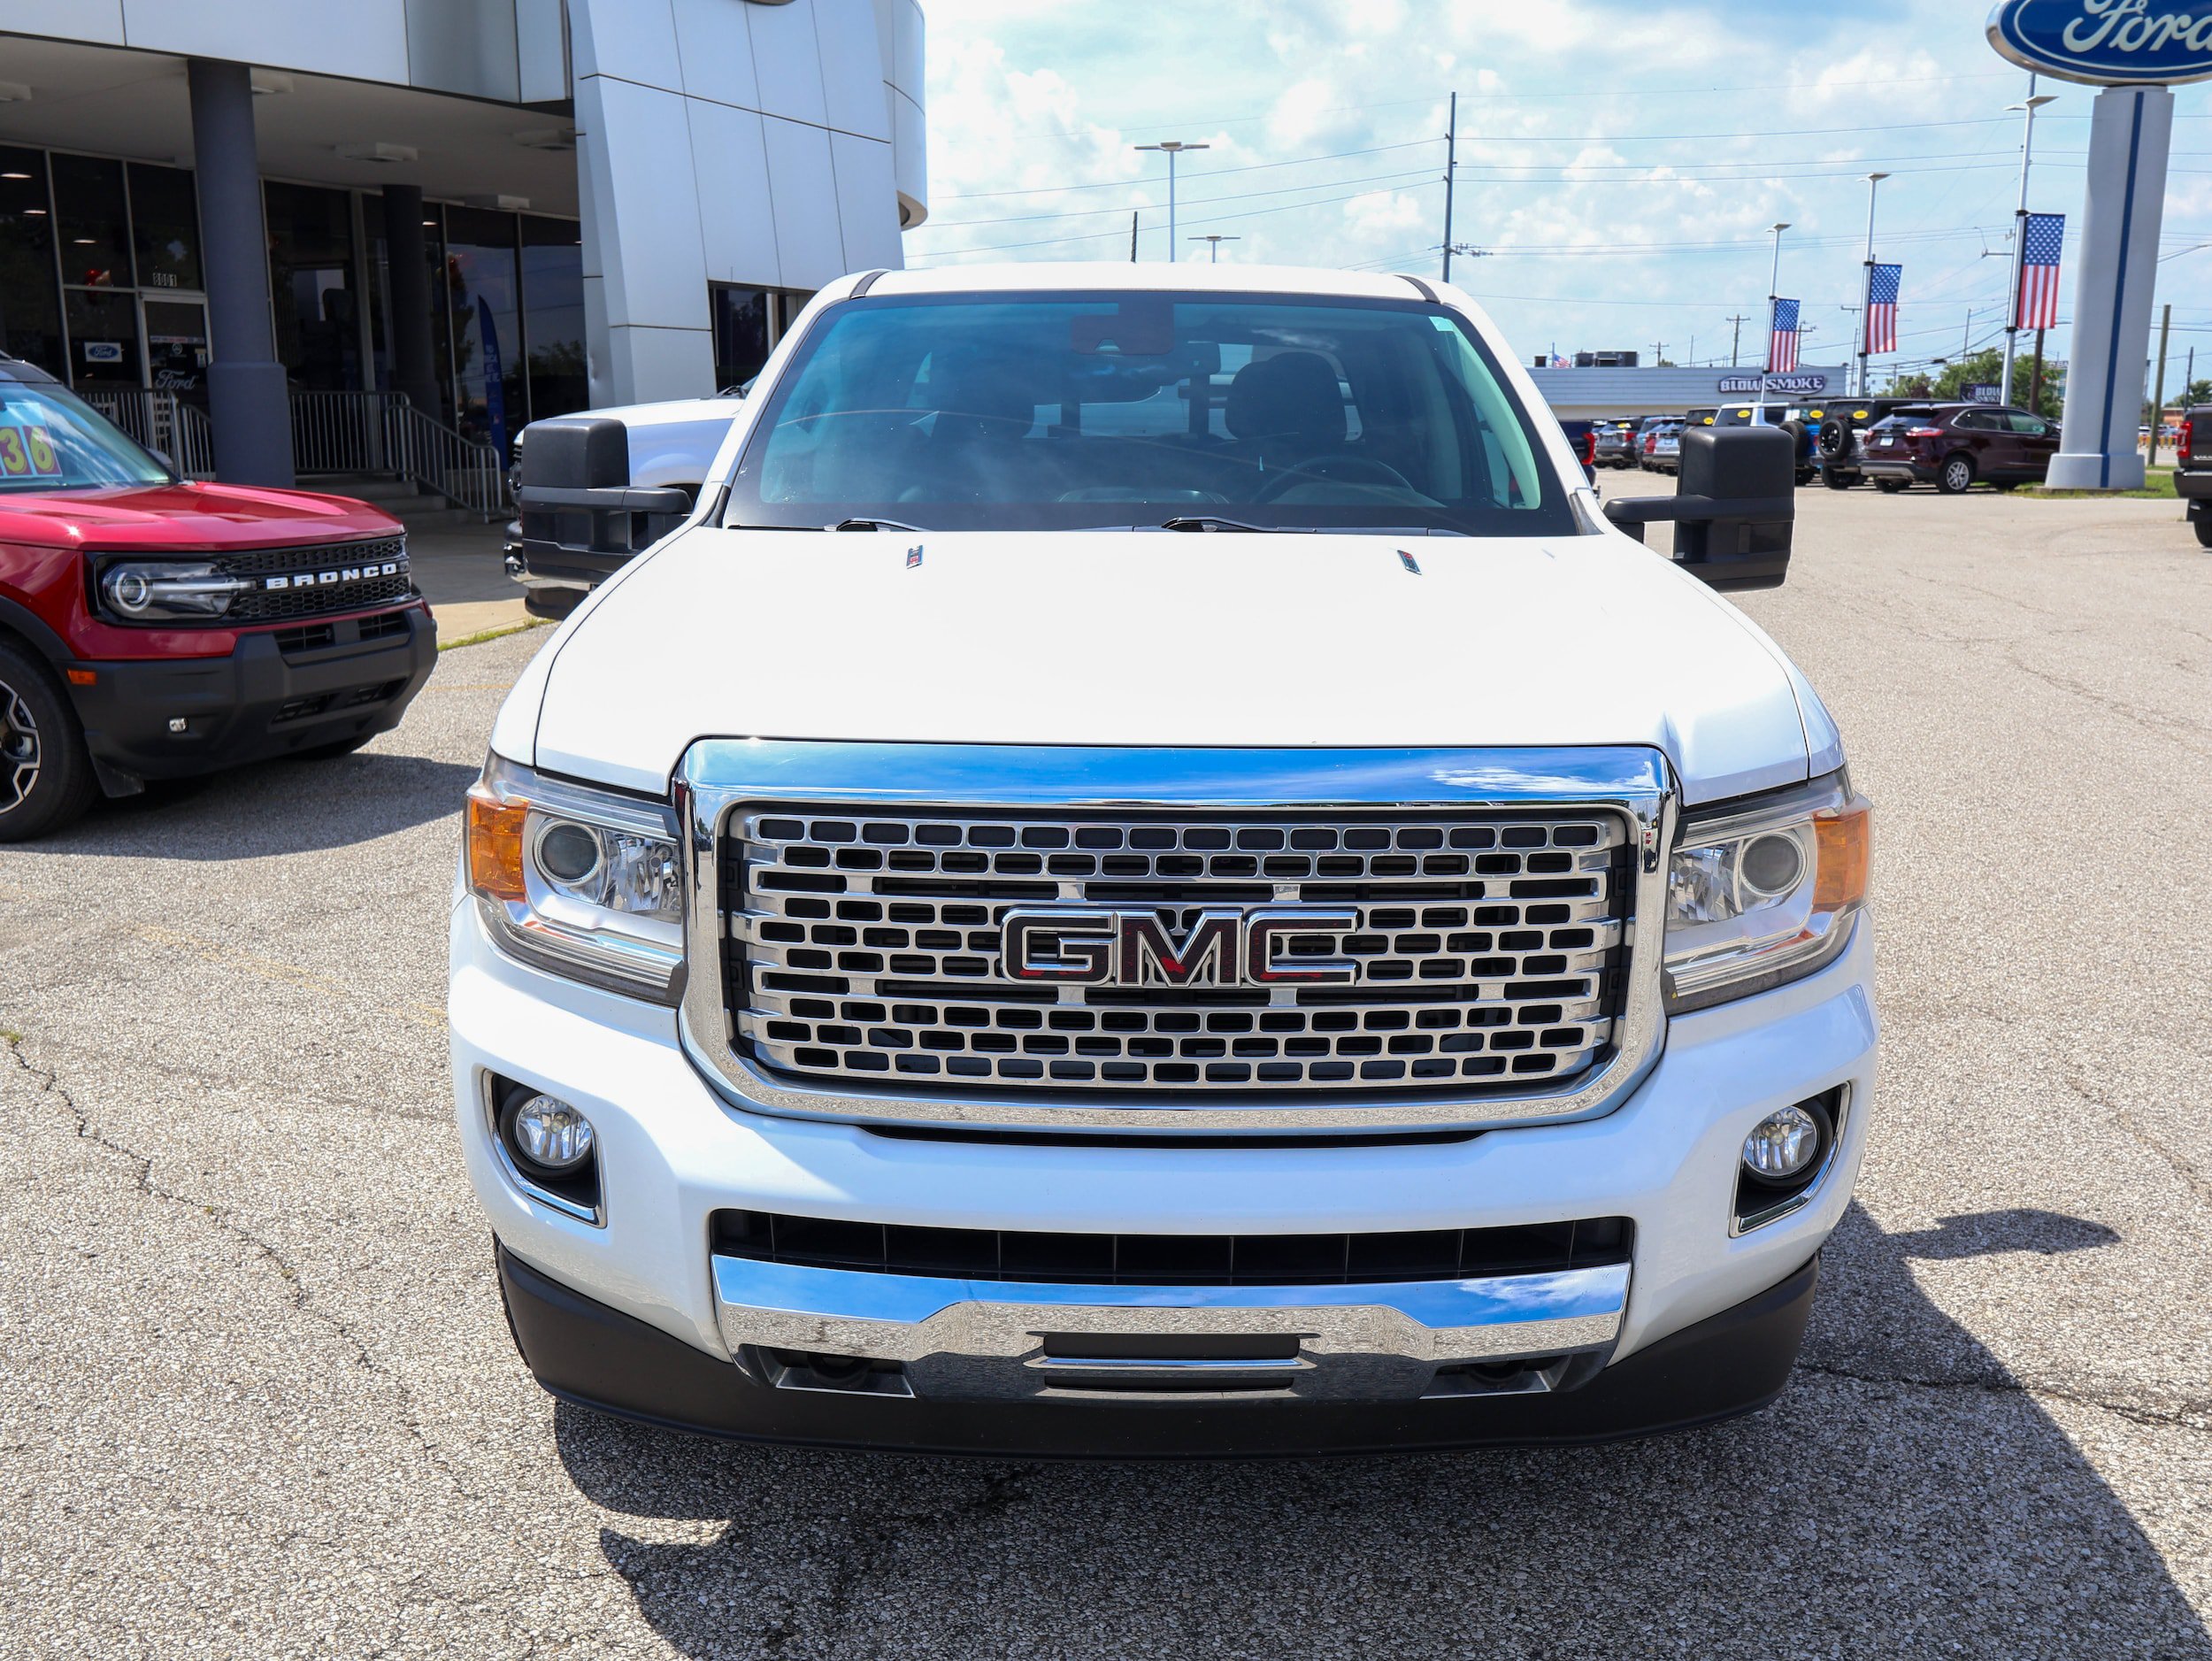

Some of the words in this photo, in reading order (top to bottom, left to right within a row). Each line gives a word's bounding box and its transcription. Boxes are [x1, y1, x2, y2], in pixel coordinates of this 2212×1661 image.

[95, 346, 113, 357] Ford
[156, 369, 199, 390] Ford
[1720, 379, 1762, 392] BLOW
[1765, 376, 1824, 390] SMOKE
[266, 563, 397, 590] BRONCO
[1001, 905, 1358, 988] GMC
